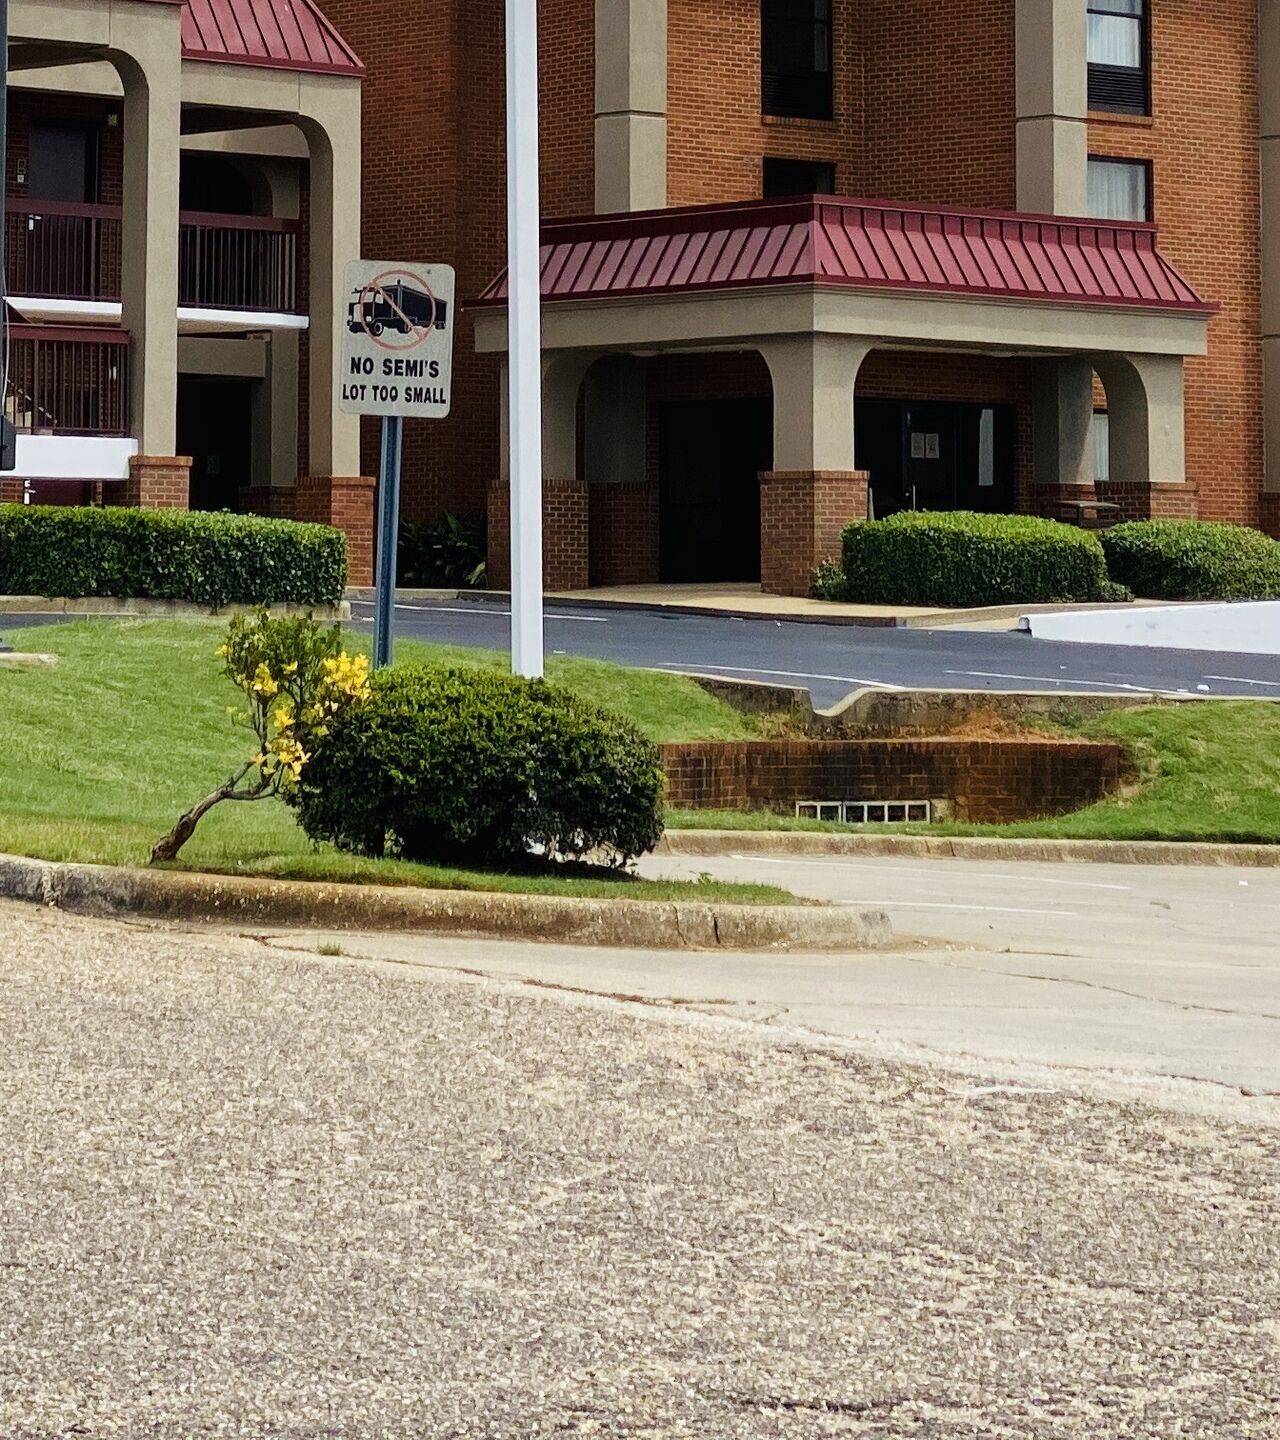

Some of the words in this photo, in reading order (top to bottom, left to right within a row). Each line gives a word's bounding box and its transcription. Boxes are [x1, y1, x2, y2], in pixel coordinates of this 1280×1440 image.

[350, 357, 374, 375] NO
[382, 358, 439, 378] SEMI'S
[342, 384, 367, 401] LOT
[372, 385, 398, 402] TOO
[404, 386, 447, 404] SMALL
